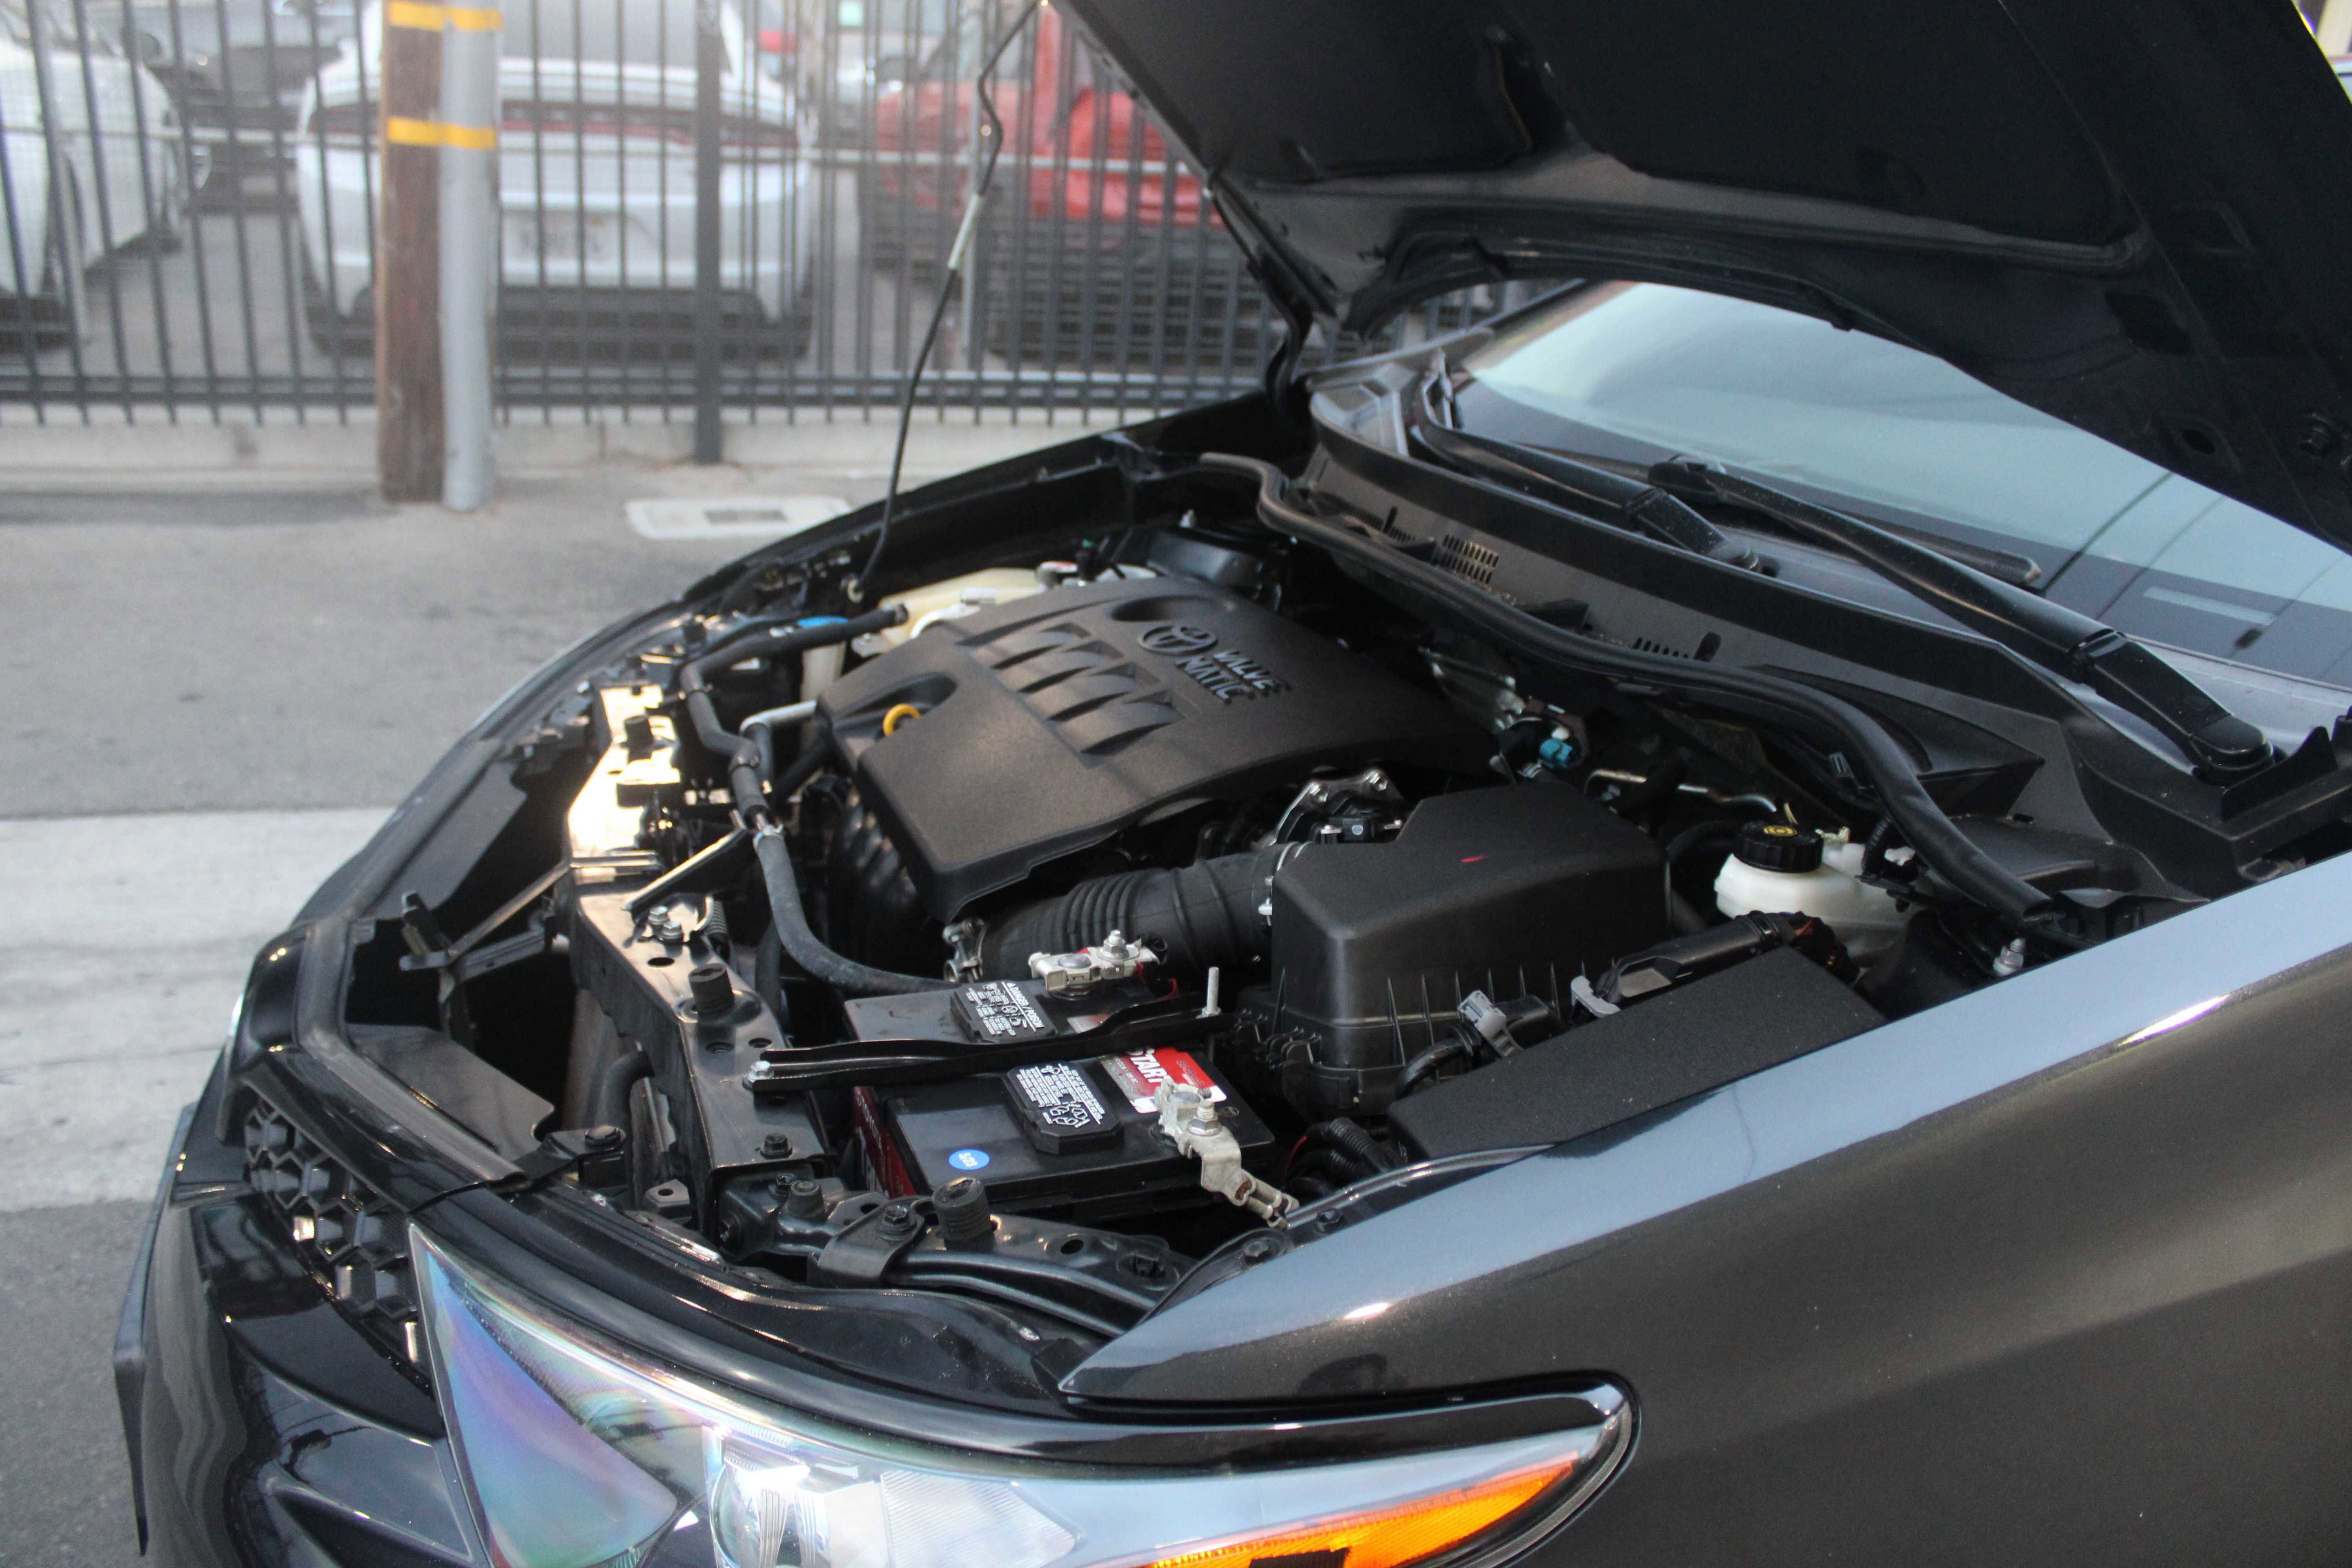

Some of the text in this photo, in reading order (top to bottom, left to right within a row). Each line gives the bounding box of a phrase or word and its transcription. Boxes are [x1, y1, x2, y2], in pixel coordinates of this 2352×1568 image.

[1176, 655, 1252, 701] MATIC
[1212, 649, 1275, 691] VALVE
[1010, 987, 1029, 1007] DANGER
[1025, 1009, 1045, 1028] POISON
